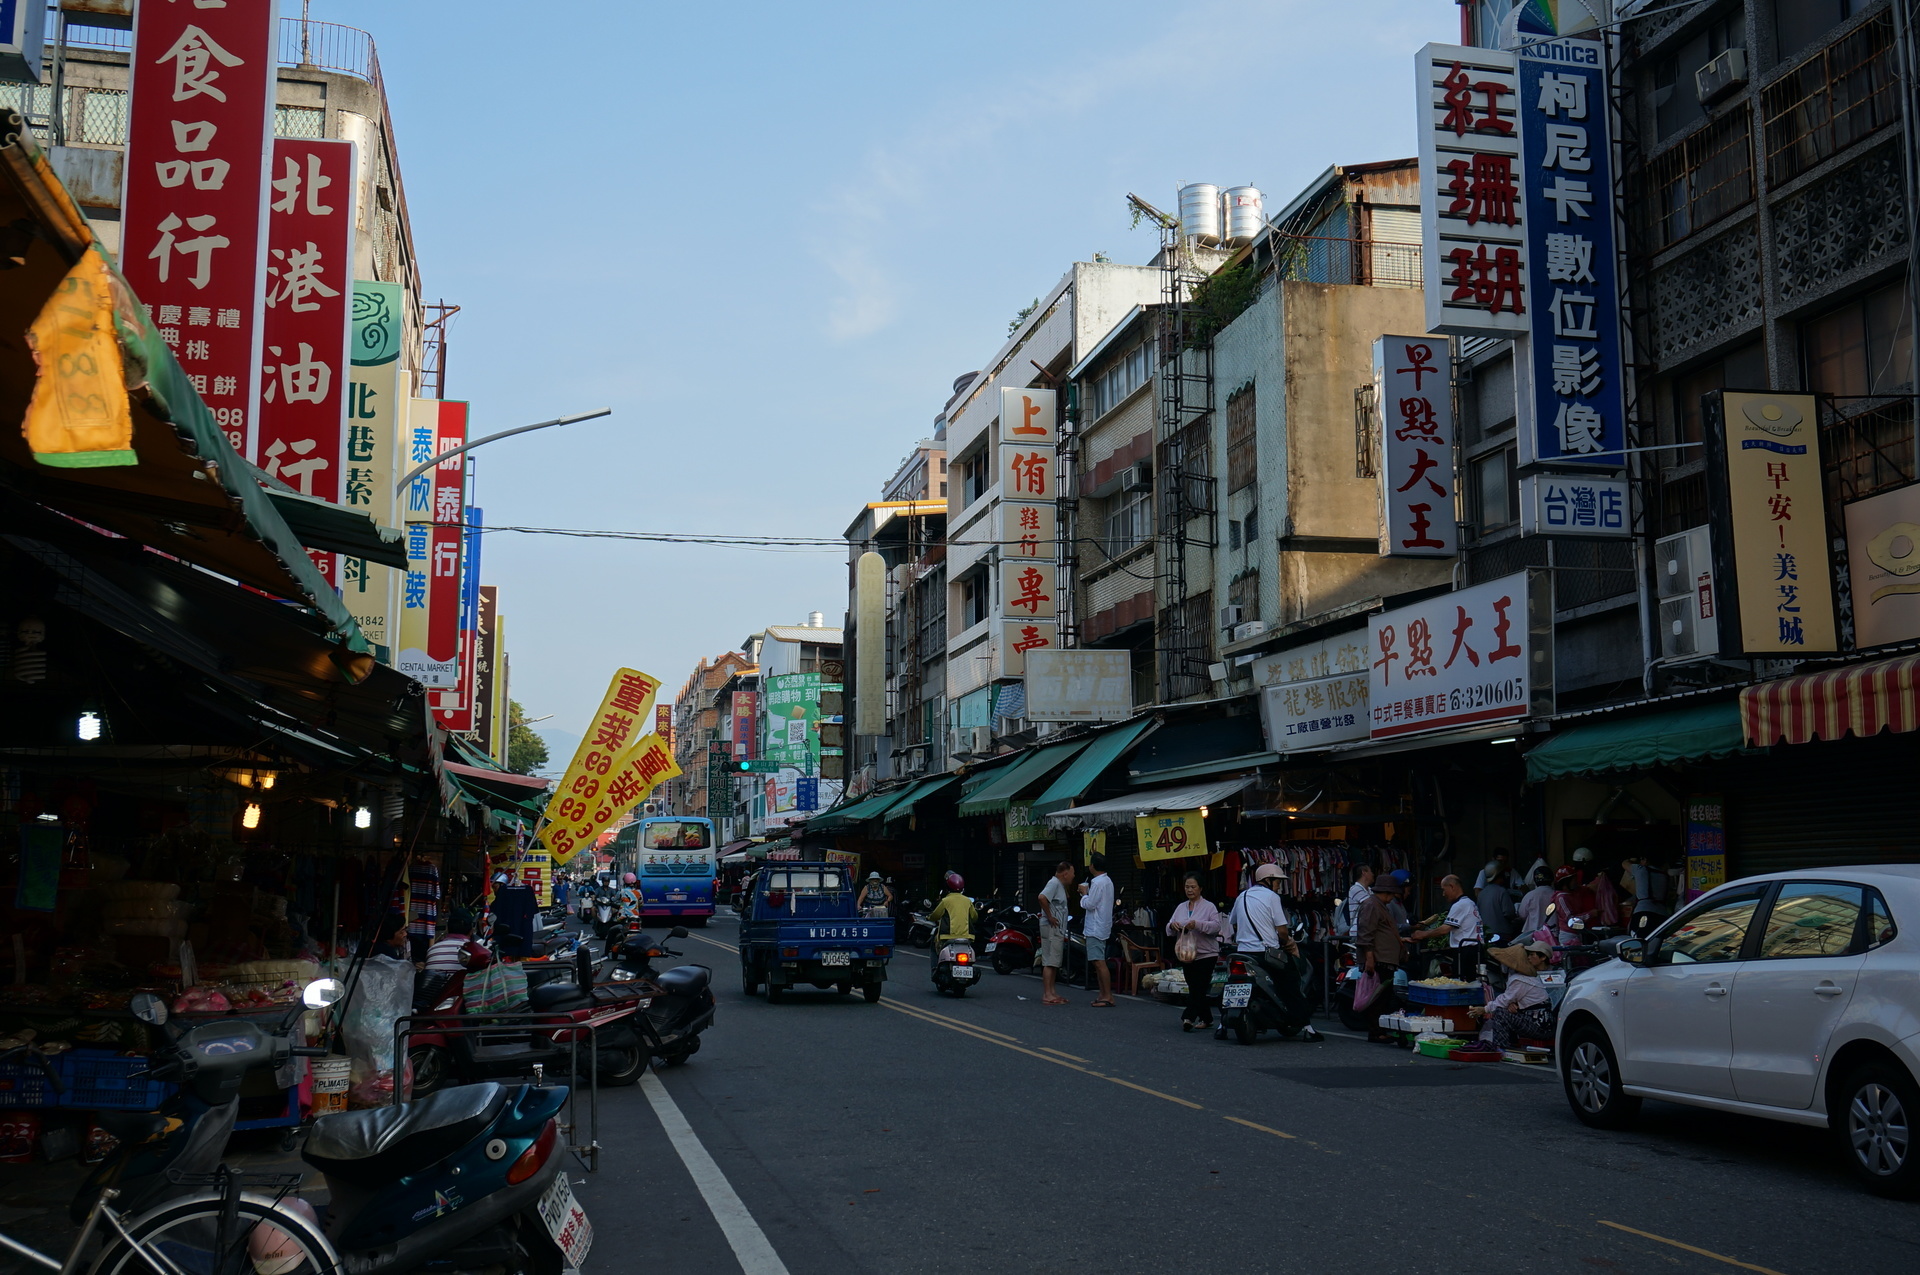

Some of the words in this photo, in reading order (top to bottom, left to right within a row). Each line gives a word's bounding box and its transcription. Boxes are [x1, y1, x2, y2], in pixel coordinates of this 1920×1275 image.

[1520, 36, 1599, 65] Konica
[148, 0, 245, 290] 食品行
[1442, 60, 1524, 315] 紅珊瑚
[1537, 71, 1604, 454] 柯尼卡數位影像
[261, 153, 341, 500] 北港油行
[1394, 343, 1447, 549] 早點大王
[433, 436, 464, 577] 明泰行
[1543, 484, 1623, 528] 台灣店
[400, 662, 426, 672] CENTAL
[427, 662, 454, 673] MARKET
[1373, 595, 1522, 687] 早點大王
[1373, 692, 1447, 725] 中式早餐專賣店
[1155, 826, 1188, 853] 49
